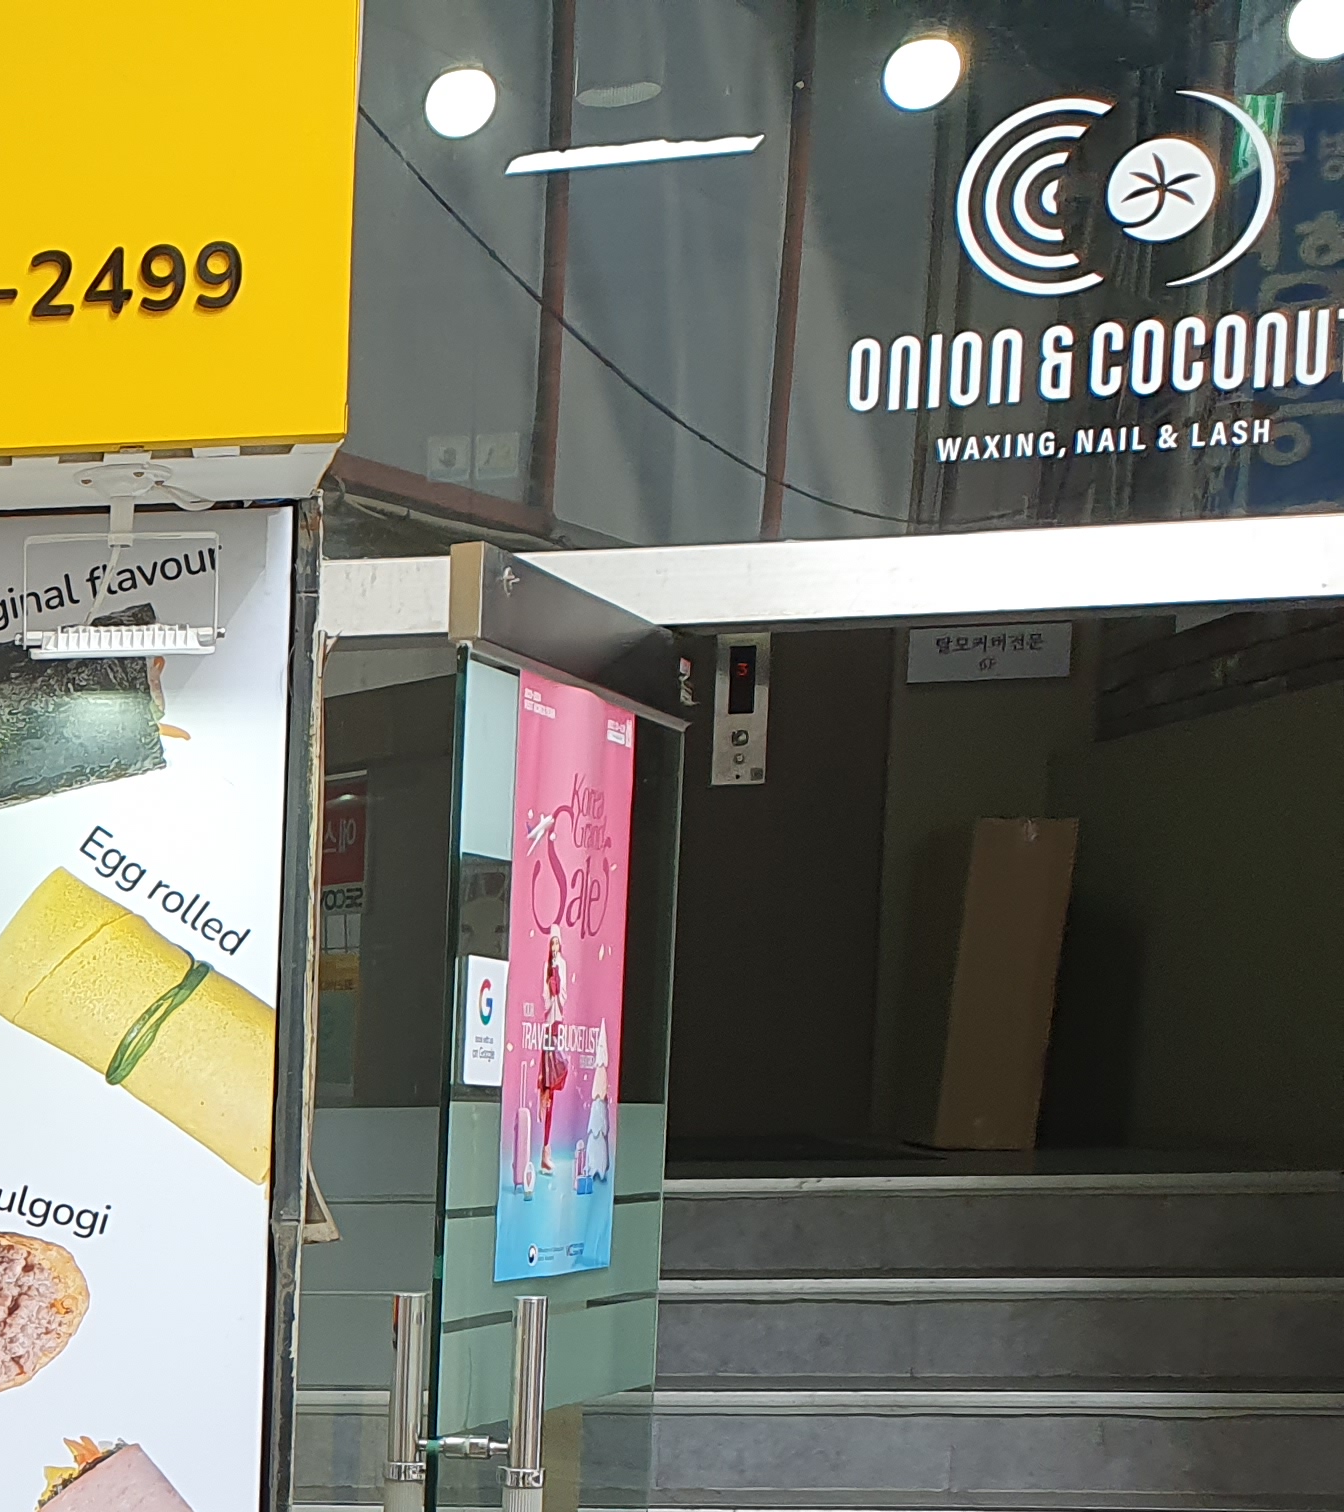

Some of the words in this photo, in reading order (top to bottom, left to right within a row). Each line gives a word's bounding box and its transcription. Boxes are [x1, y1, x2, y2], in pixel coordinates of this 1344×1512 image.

[848, 328, 1024, 413] ONION
[1037, 324, 1074, 400] &
[936, 432, 1066, 463] WAXING,
[1075, 427, 1147, 455] NAIL
[1158, 424, 1178, 449] &
[1191, 418, 1272, 446] LASH
[85, 543, 224, 602] flavour
[79, 825, 148, 892] Egg
[147, 875, 252, 957] rolled
[531, 805, 610, 940] Sale
[521, 1021, 555, 1051] TRAVEL
